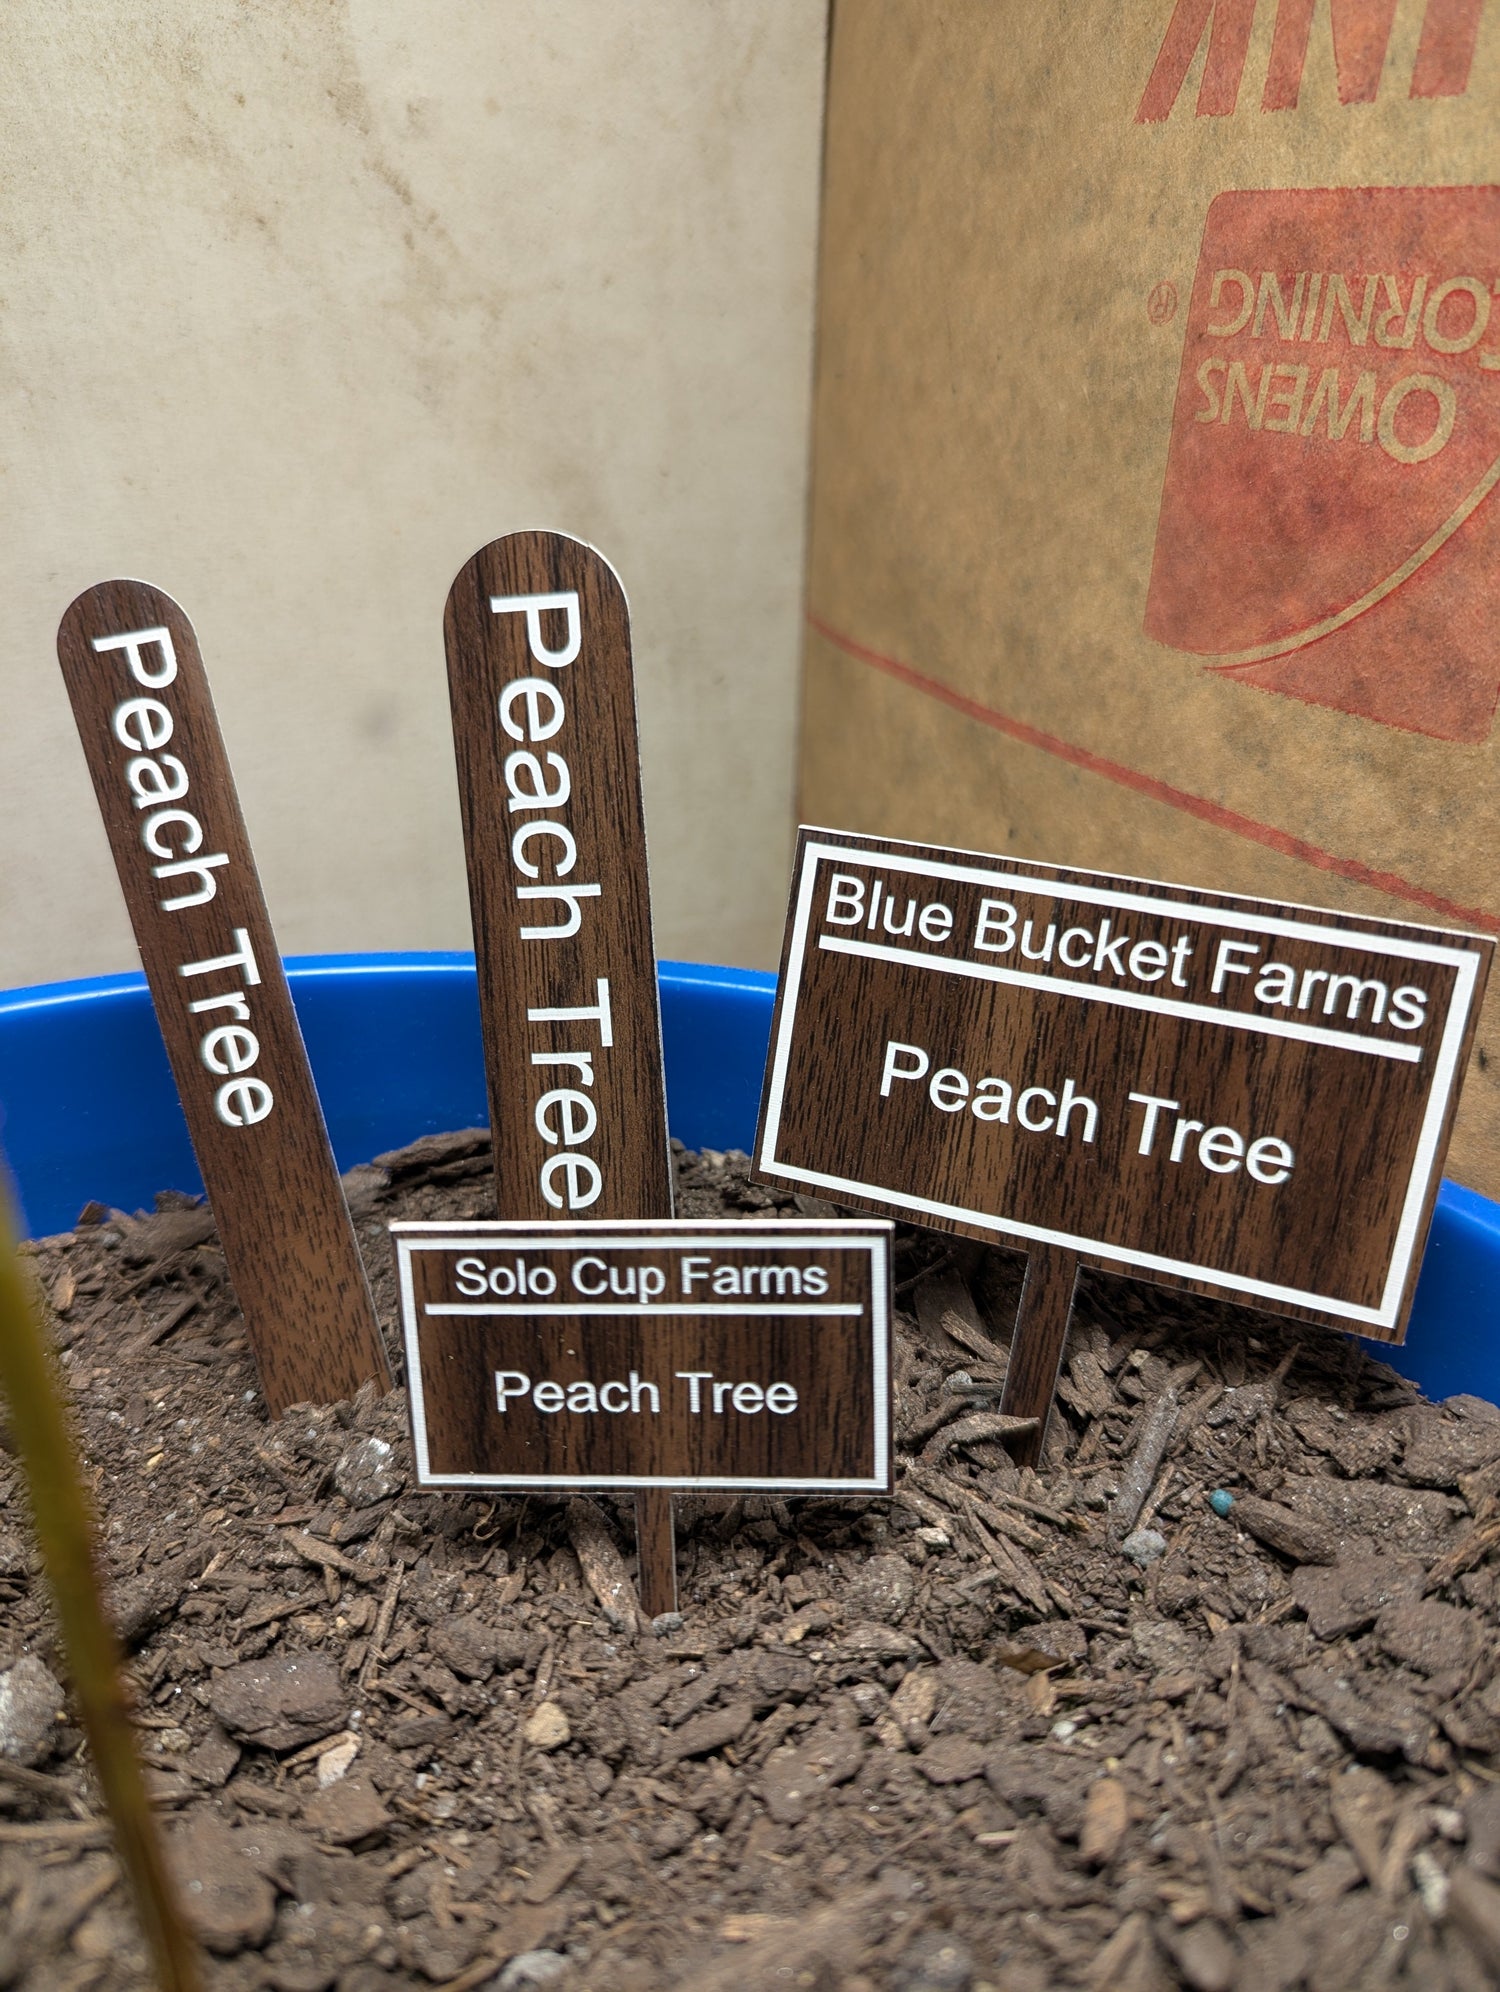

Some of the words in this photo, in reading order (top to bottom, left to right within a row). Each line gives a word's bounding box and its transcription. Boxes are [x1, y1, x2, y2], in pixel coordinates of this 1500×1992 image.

[1194, 356, 1457, 464] OWENS
[490, 591, 602, 940] Peach
[92, 626, 230, 912] Peach
[180, 927, 274, 1127] Tree
[825, 873, 953, 942] Blue
[973, 898, 1193, 988] Bucket
[1210, 939, 1428, 1030] Farms
[527, 978, 614, 1210] Tree
[879, 1040, 1098, 1143] Peach
[1127, 1092, 1294, 1185] Tree
[455, 1257, 557, 1296] Solo
[572, 1257, 666, 1304] Cup
[681, 1257, 829, 1296] Farms
[495, 1371, 660, 1413] Peach
[675, 1372, 799, 1414] Tree
